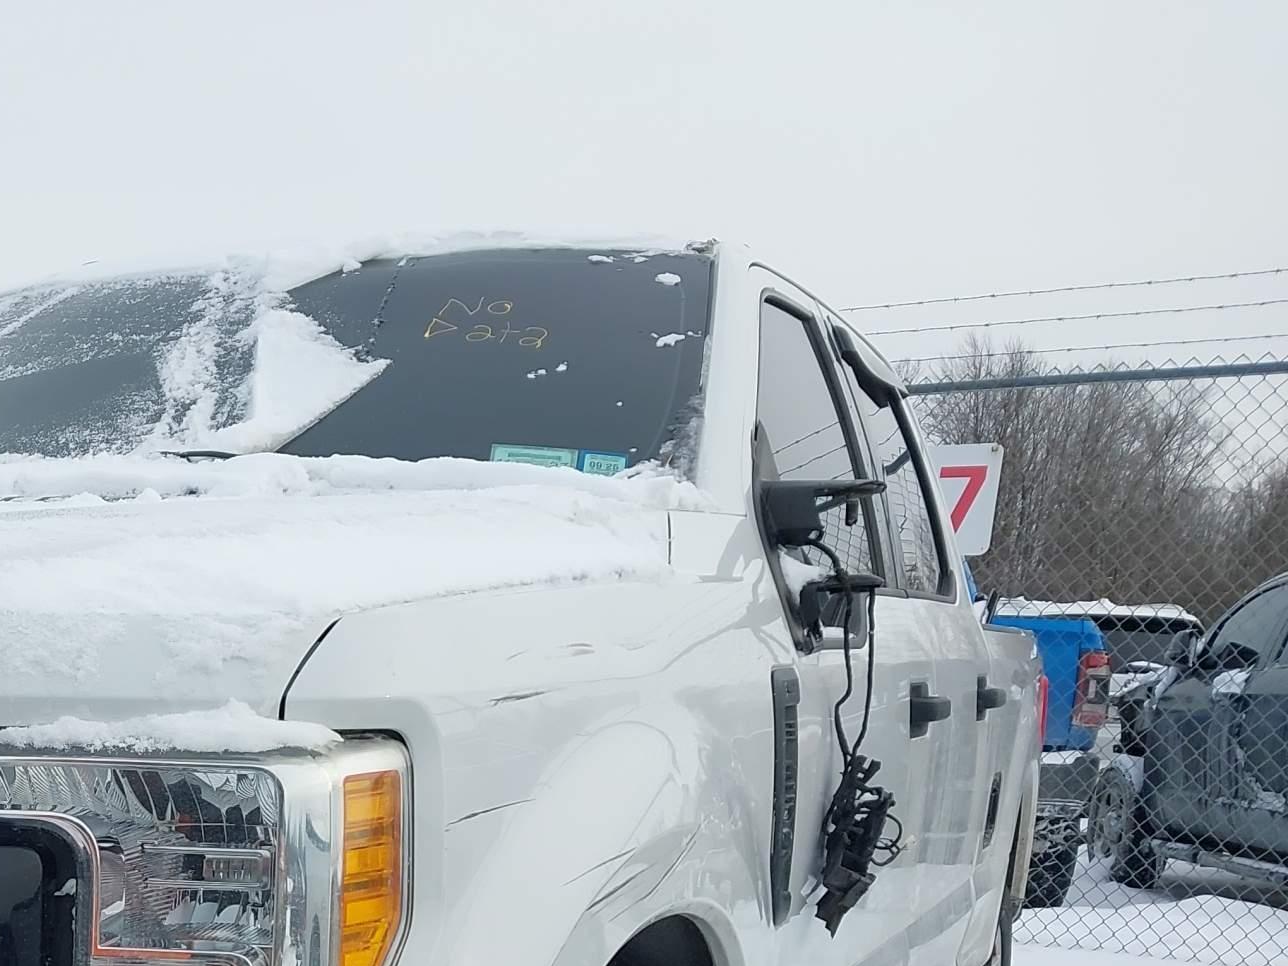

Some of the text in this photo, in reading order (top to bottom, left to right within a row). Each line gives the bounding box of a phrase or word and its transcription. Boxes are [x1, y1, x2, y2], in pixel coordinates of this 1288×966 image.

[438, 296, 513, 316] No
[423, 317, 548, 349] Data
[939, 466, 989, 534] 7
